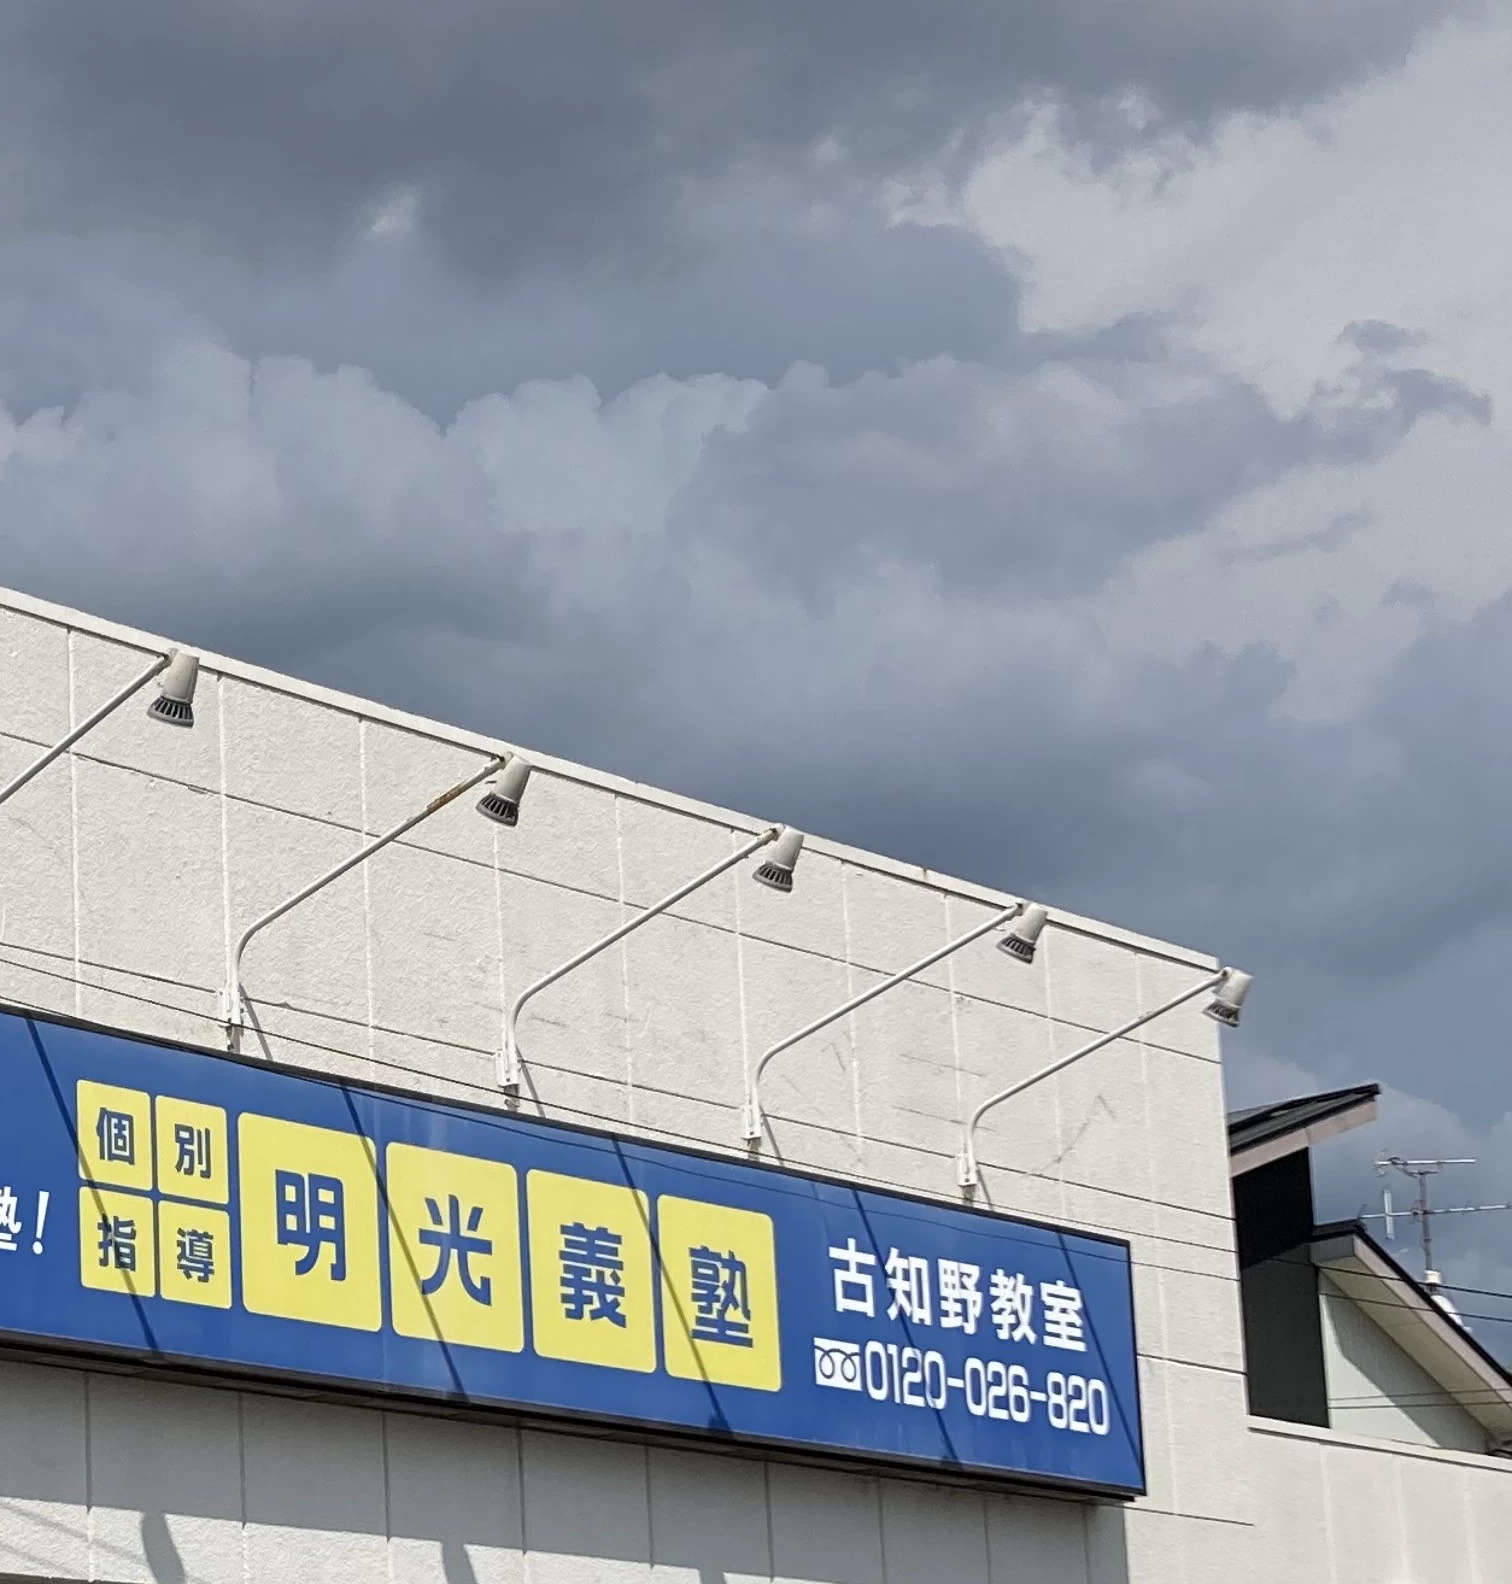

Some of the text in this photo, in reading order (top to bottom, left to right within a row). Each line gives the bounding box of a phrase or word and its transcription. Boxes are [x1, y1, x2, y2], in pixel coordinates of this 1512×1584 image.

[96, 1106, 212, 1181] 個別
[97, 1215, 215, 1284] 指導
[276, 1171, 754, 1349] 明光義塾
[828, 1237, 1087, 1353] 古知野教室
[864, 1340, 1111, 1436] 0120-026-820
